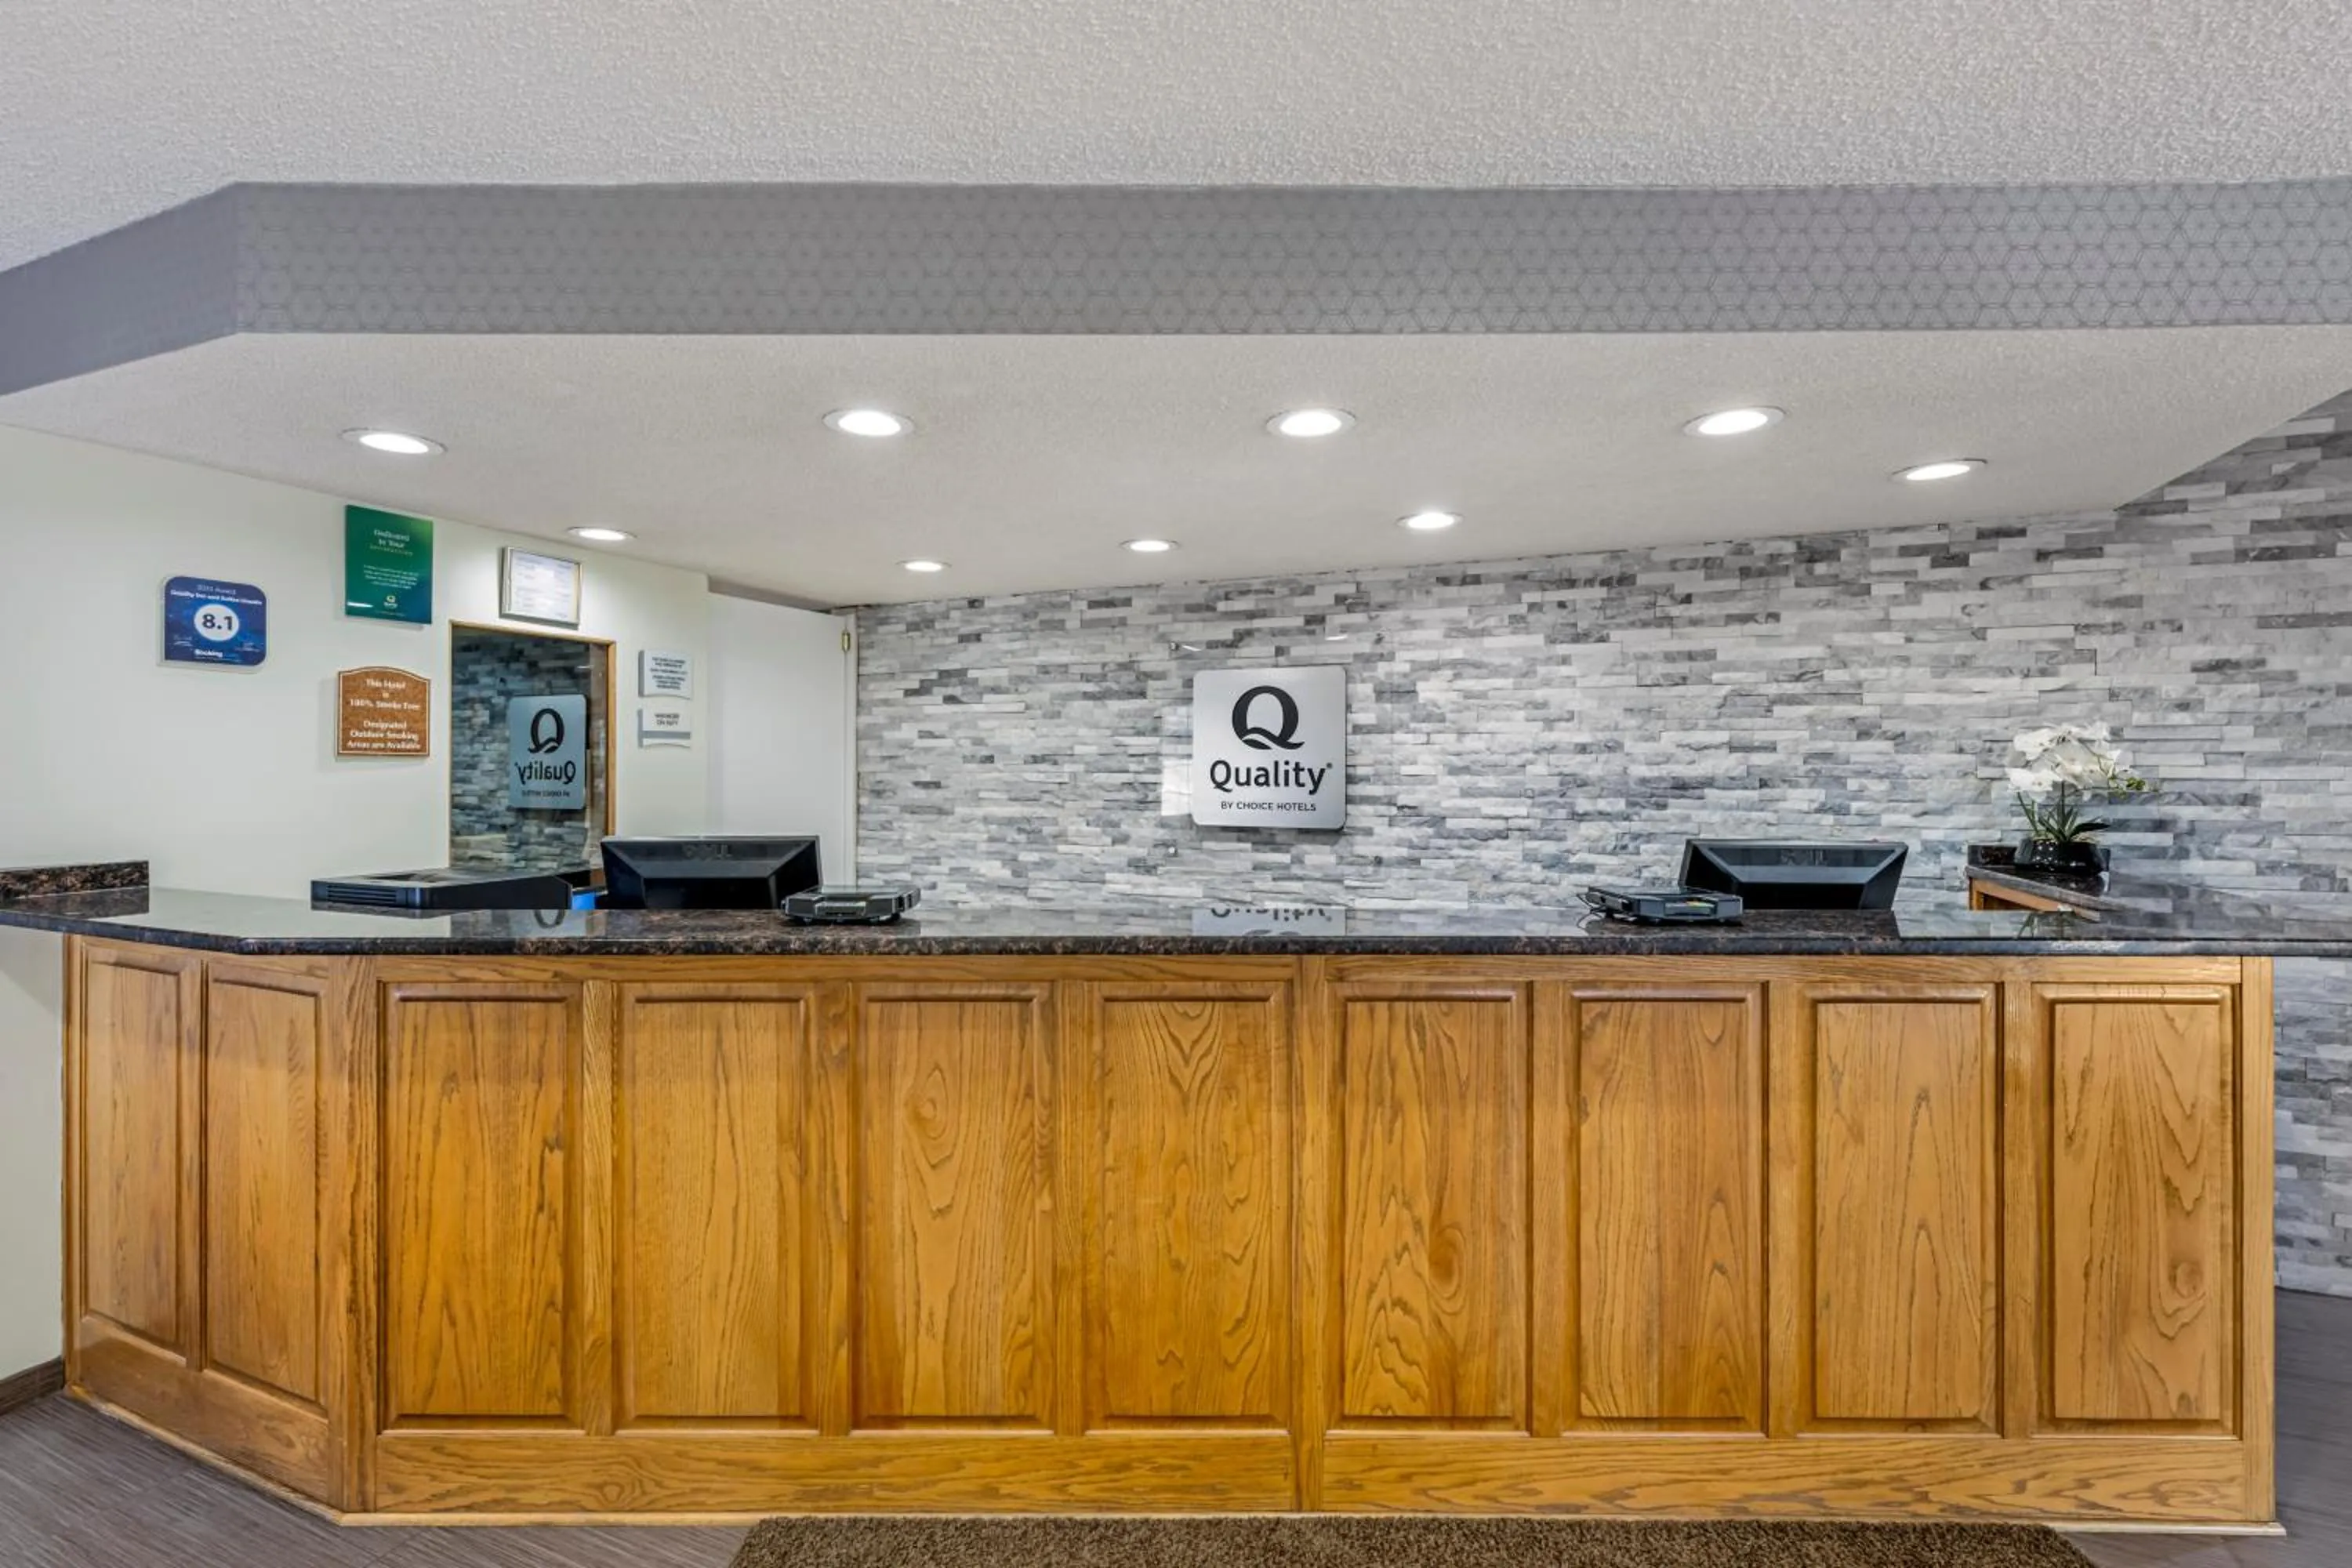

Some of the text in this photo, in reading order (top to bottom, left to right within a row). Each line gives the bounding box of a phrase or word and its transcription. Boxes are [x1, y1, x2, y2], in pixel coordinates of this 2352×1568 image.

[202, 614, 233, 630] 8.1
[1232, 685, 1305, 750] Q
[364, 720, 407, 730] Designated
[387, 731, 419, 741] Smoking
[1210, 760, 1327, 795] Quality
[1236, 802, 1274, 811] CHOICE
[1276, 803, 1316, 811] HOTELS
